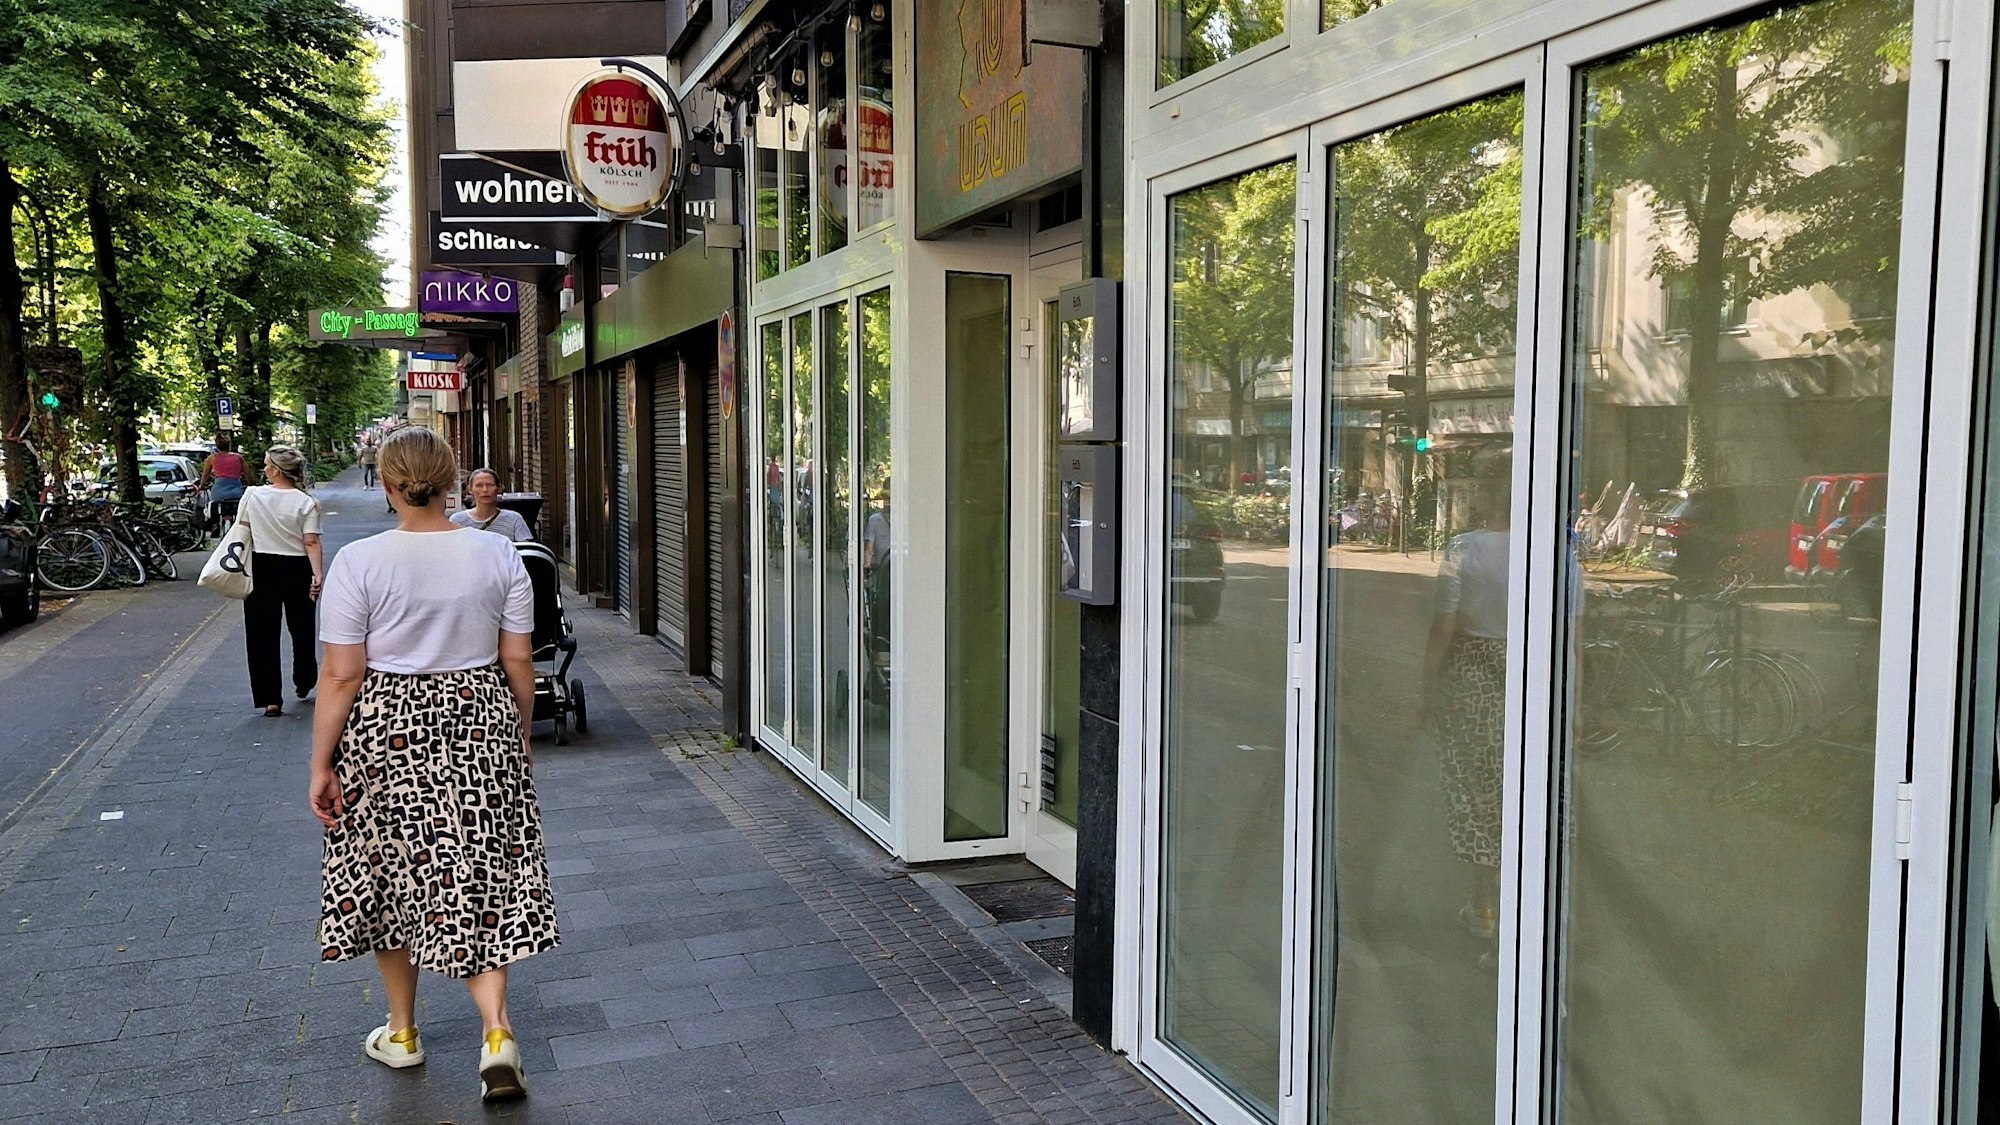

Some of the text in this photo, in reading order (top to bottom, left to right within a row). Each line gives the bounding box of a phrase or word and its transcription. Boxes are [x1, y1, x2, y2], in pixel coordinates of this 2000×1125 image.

[584, 131, 656, 172] früh
[600, 167, 642, 177] KÖLSCH
[438, 229, 540, 250] schla
[321, 311, 351, 338] City
[413, 373, 454, 389] KIOSK
